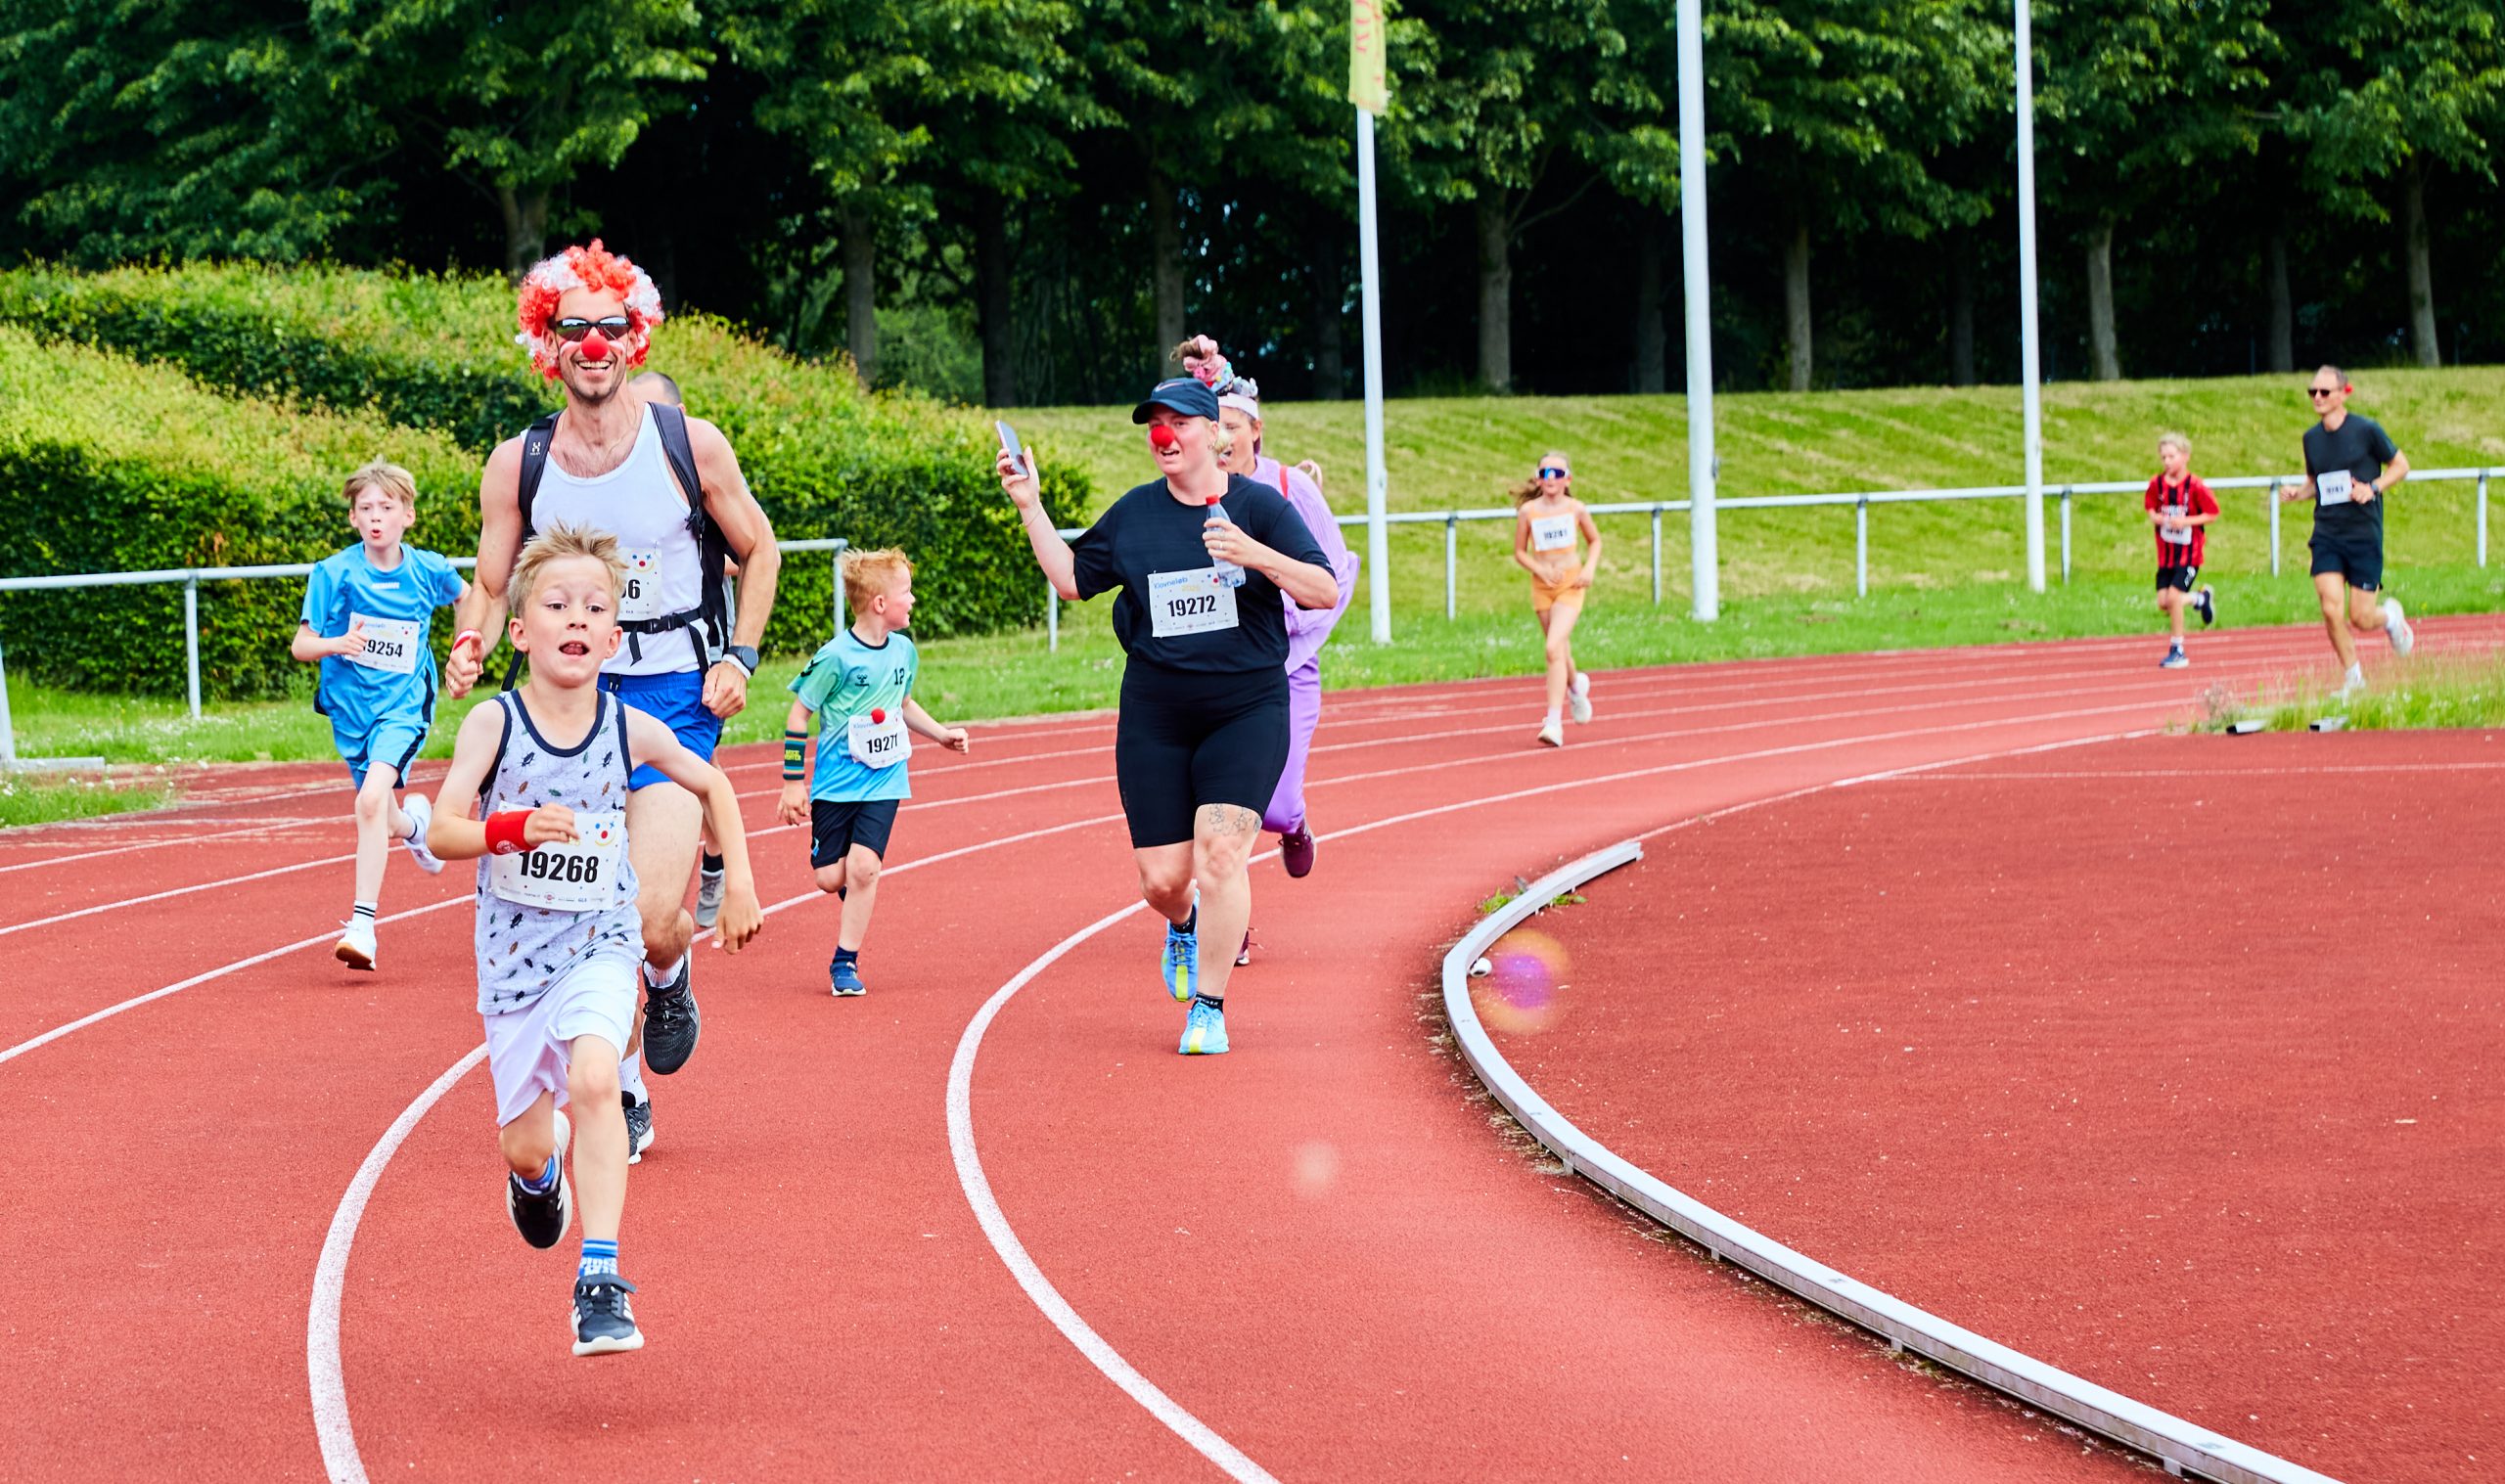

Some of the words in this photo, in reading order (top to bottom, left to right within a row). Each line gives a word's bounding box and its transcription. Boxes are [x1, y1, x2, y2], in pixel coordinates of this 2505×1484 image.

[1167, 595, 1216, 617] 19272
[363, 639, 403, 657] 9254
[893, 667, 905, 685] 12
[866, 733, 898, 753] 19271
[519, 850, 600, 883] 19268
